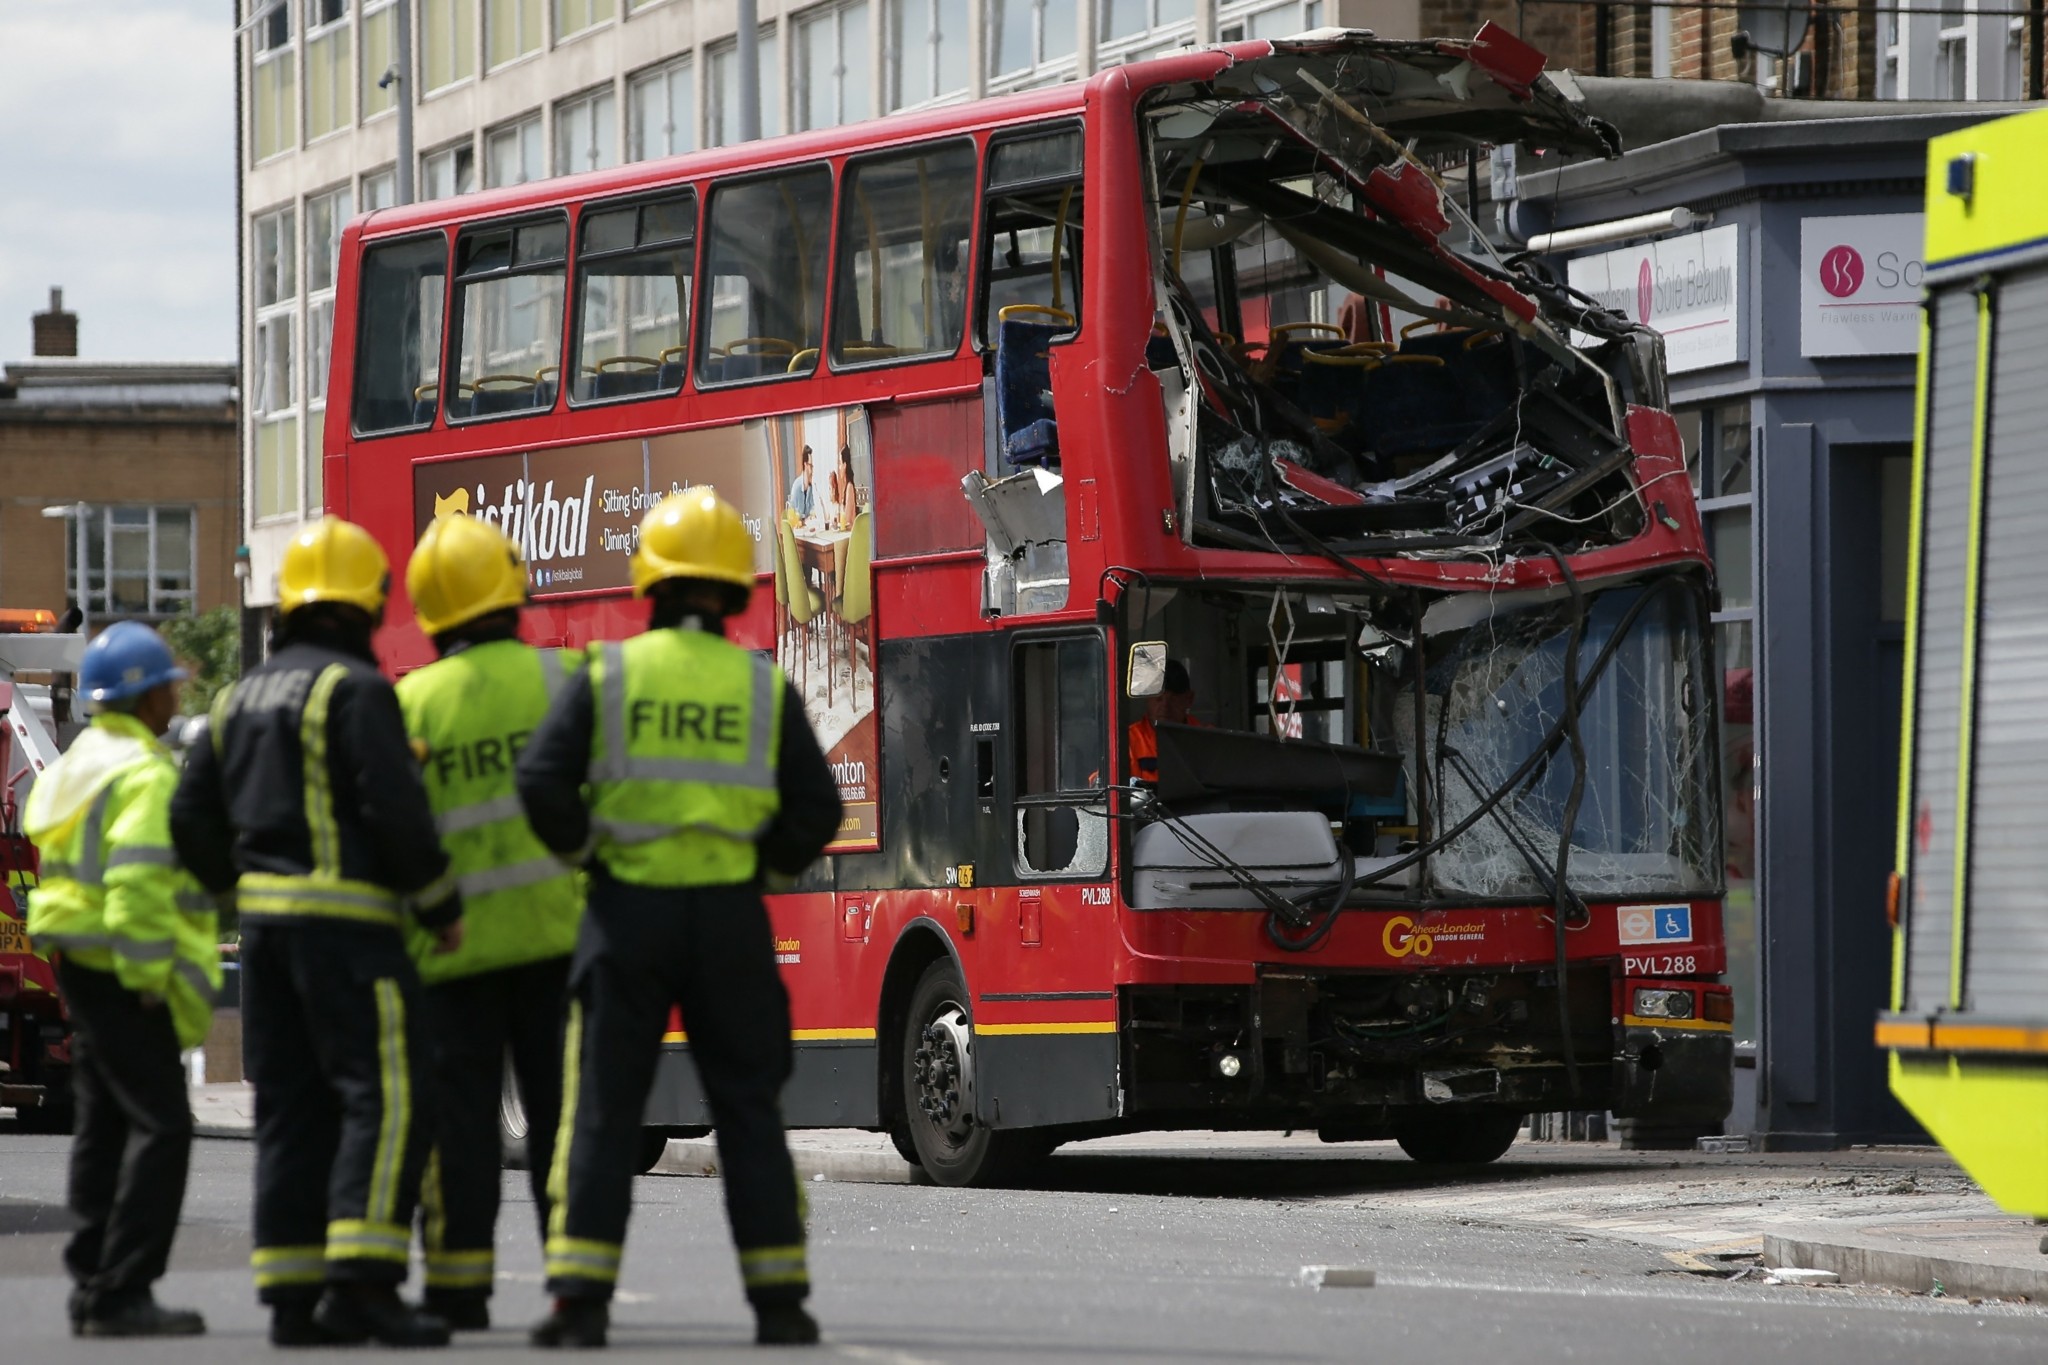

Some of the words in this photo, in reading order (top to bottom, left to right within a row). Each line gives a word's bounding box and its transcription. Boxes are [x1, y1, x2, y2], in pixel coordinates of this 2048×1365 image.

[1656, 264, 1682, 313] Sole
[1687, 257, 1731, 311] Beauty
[1821, 312, 1875, 324] Flawless
[1881, 310, 1918, 322] Waxin
[603, 488, 629, 518] Sitting
[632, 486, 662, 512] Groups
[604, 525, 631, 556] Dining
[629, 699, 742, 745] FIRE
[830, 753, 865, 785] onton
[1081, 887, 1111, 905] PVL288
[0, 937, 23, 951] PA
[1383, 916, 1433, 957] Go
[1410, 923, 1485, 935] Ahead-London
[1434, 934, 1458, 942] LONDON
[1459, 933, 1485, 941] GENERAL
[1624, 955, 1697, 976] PVL288
